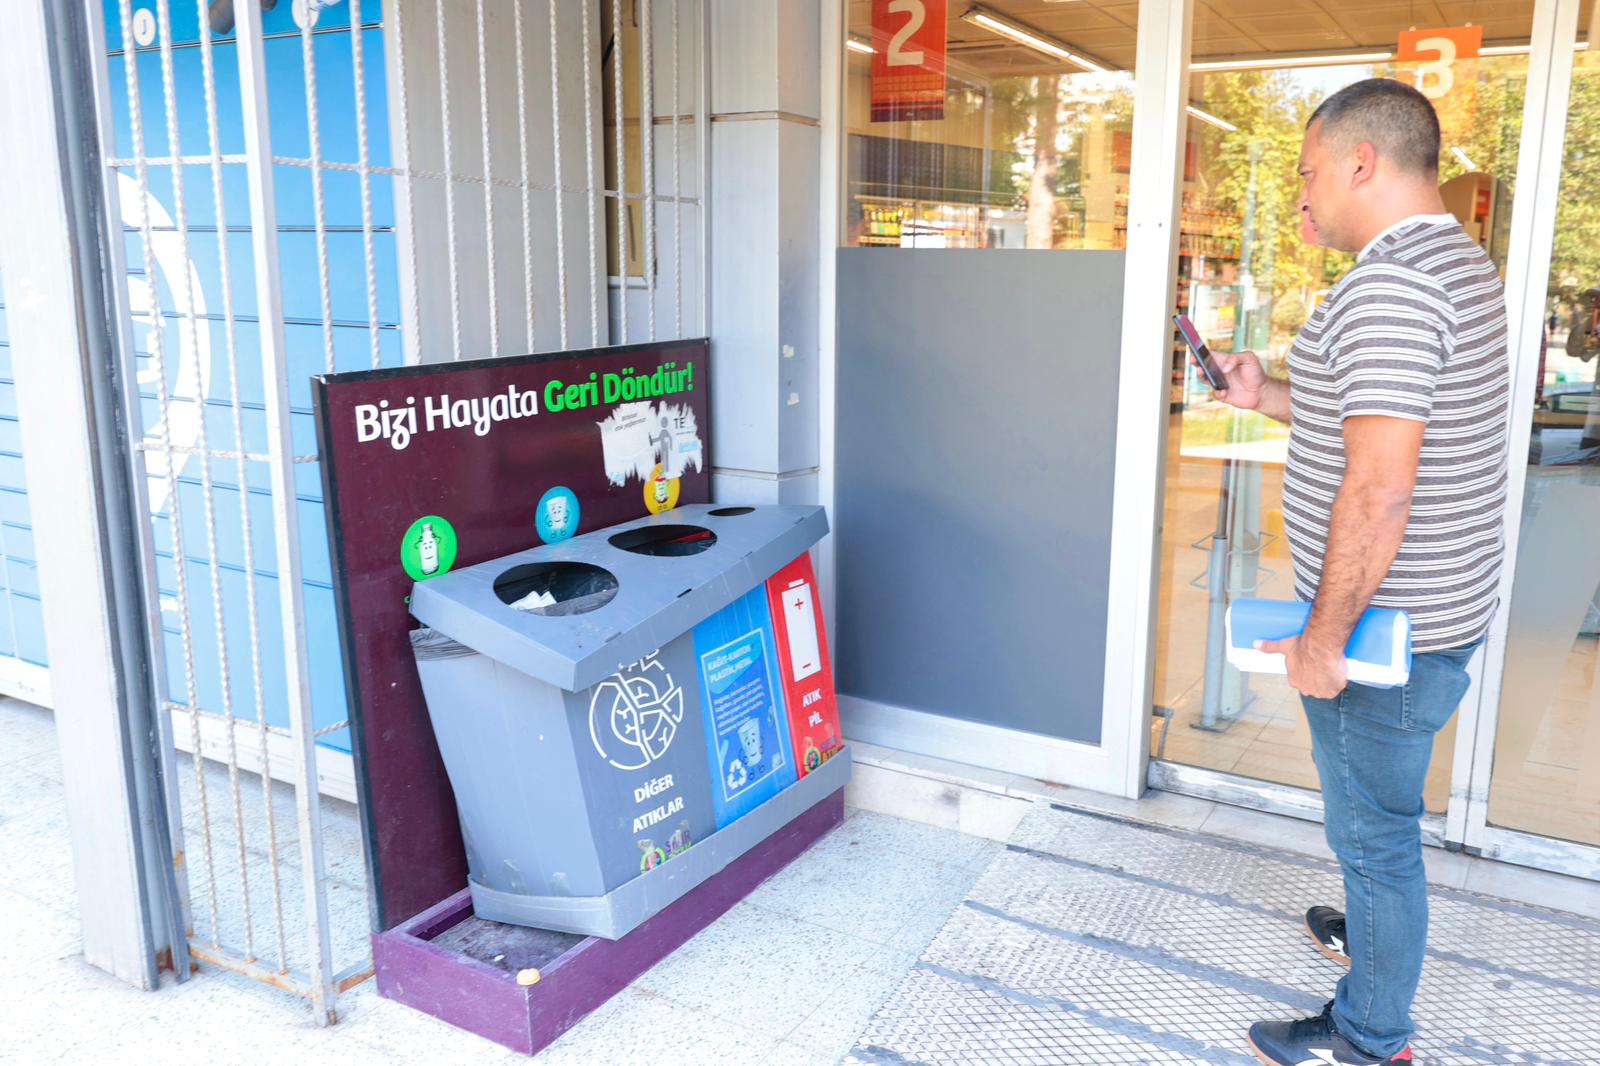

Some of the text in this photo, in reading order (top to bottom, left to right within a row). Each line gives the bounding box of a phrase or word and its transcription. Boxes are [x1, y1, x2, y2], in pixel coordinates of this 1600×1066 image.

[886, 0, 926, 67] 2
[1416, 37, 1456, 99] 3
[355, 361, 694, 450] Bizi Hayata Geri Döndür!
[802, 688, 822, 708] ATIK
[808, 711, 824, 727] PİL
[633, 774, 675, 804] DİĞER
[633, 796, 685, 833] ATIKLAR
